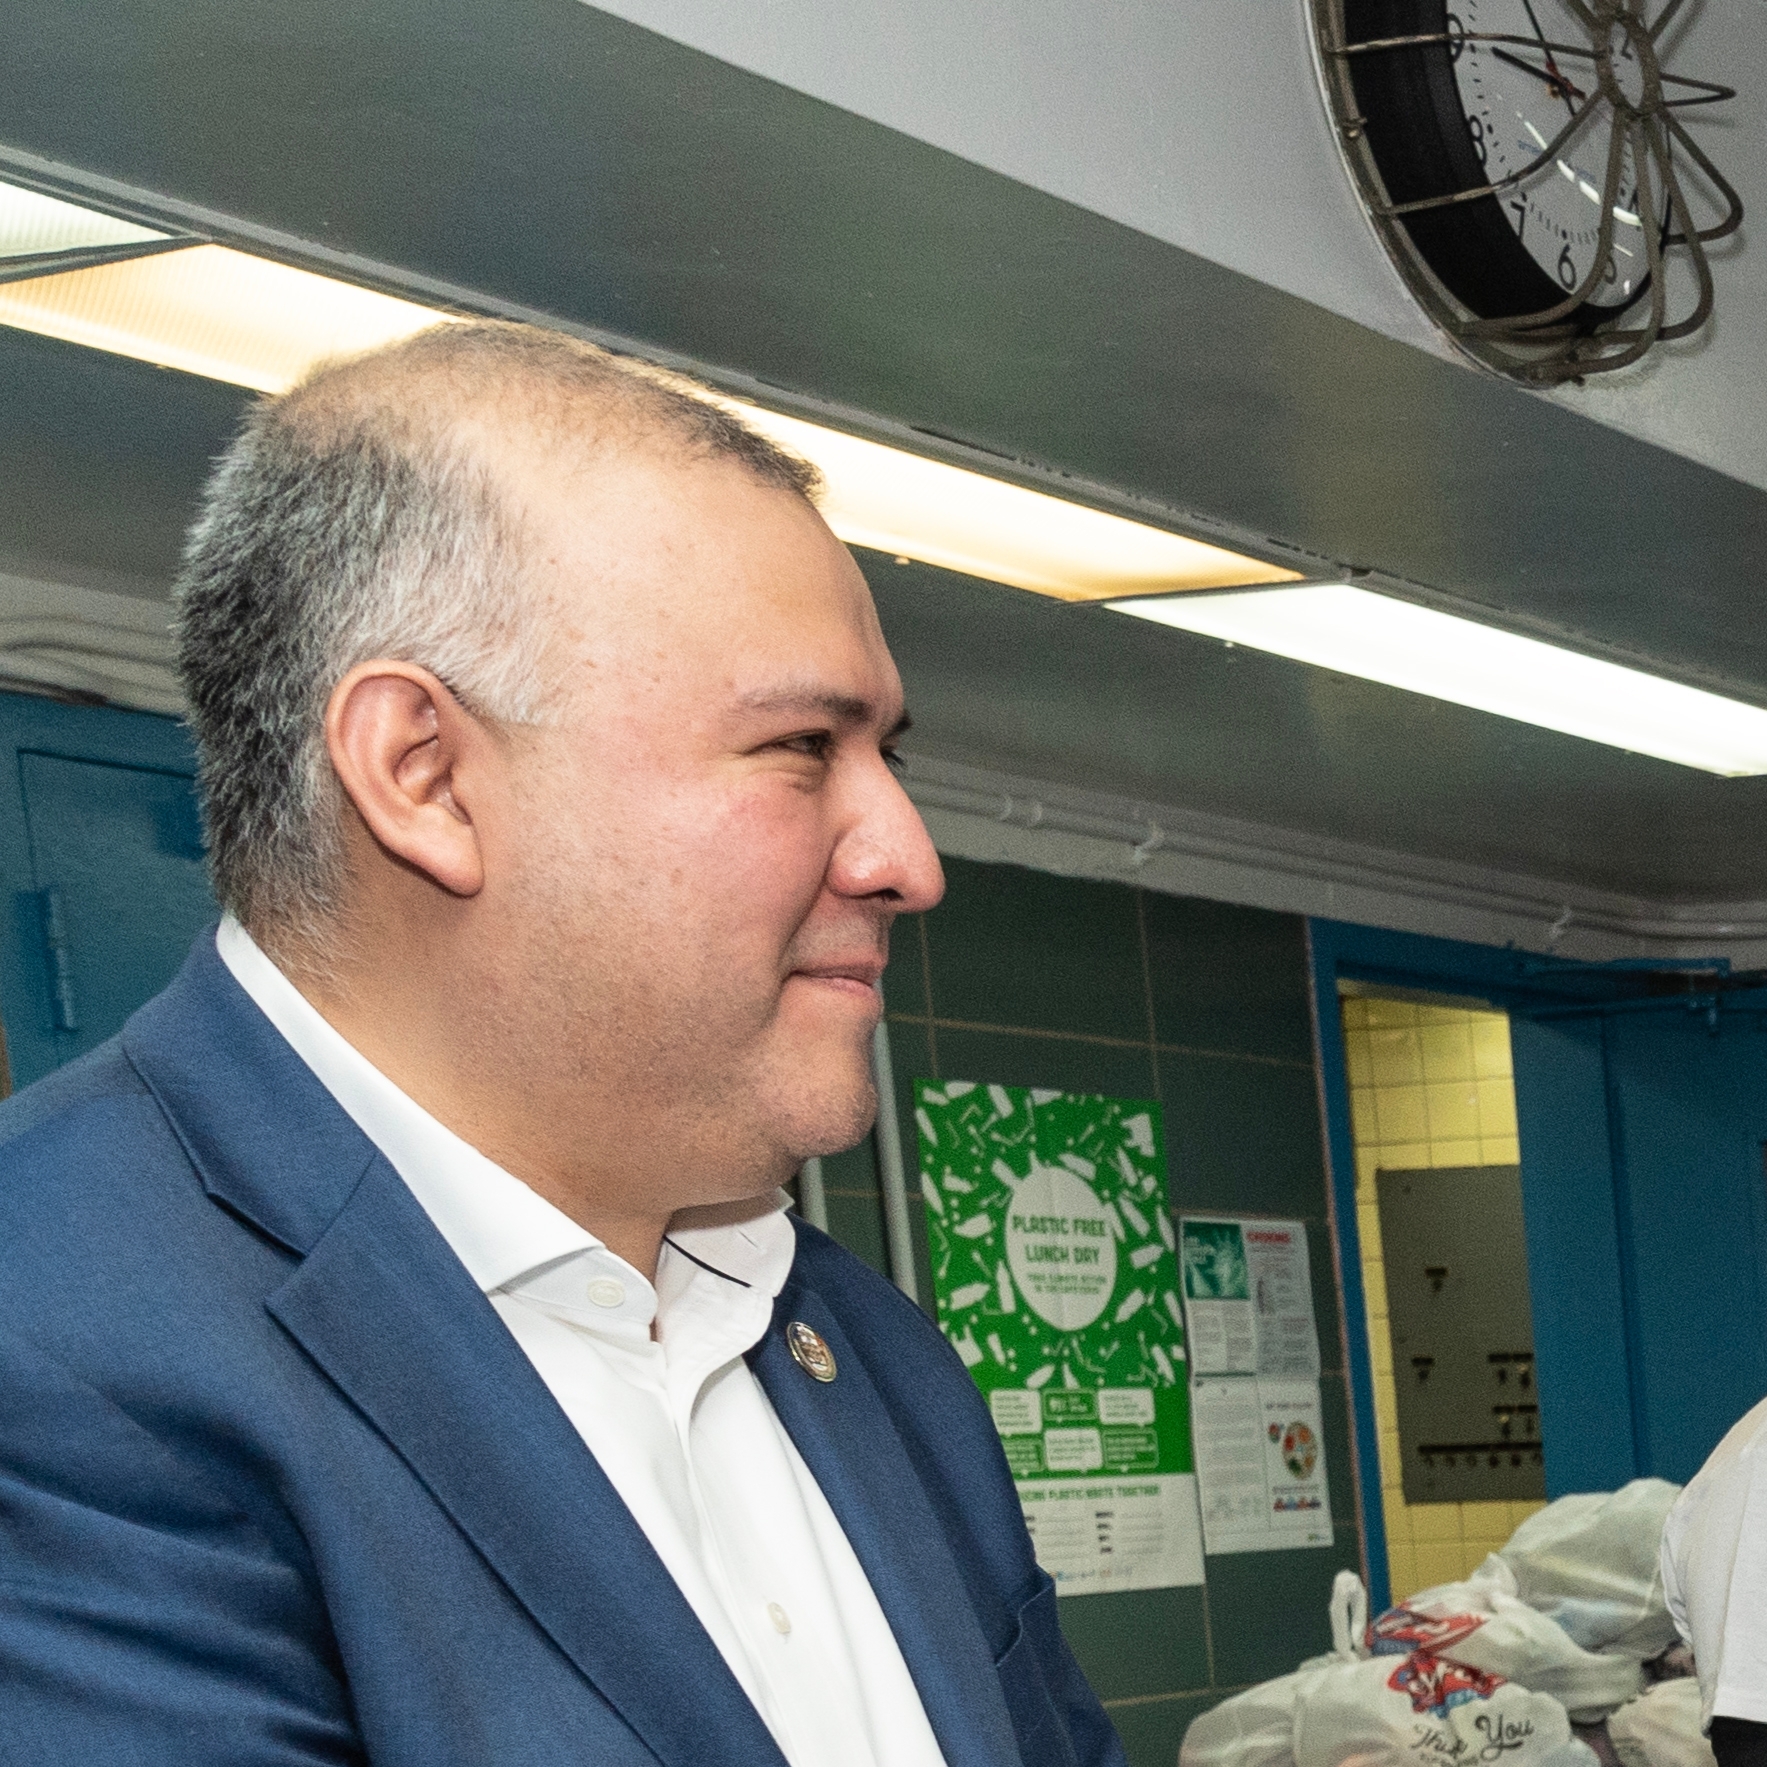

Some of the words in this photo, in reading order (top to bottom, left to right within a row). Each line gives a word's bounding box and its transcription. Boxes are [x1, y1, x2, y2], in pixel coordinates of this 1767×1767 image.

[1013, 1214, 1069, 1235] PLASTIC
[1073, 1218, 1106, 1237] FREE
[1025, 1245, 1069, 1262] LUNCH
[1073, 1246, 1099, 1265] DAY
[1118, 1484, 1160, 1497] TOGETHER
[1475, 1714, 1535, 1762] You
